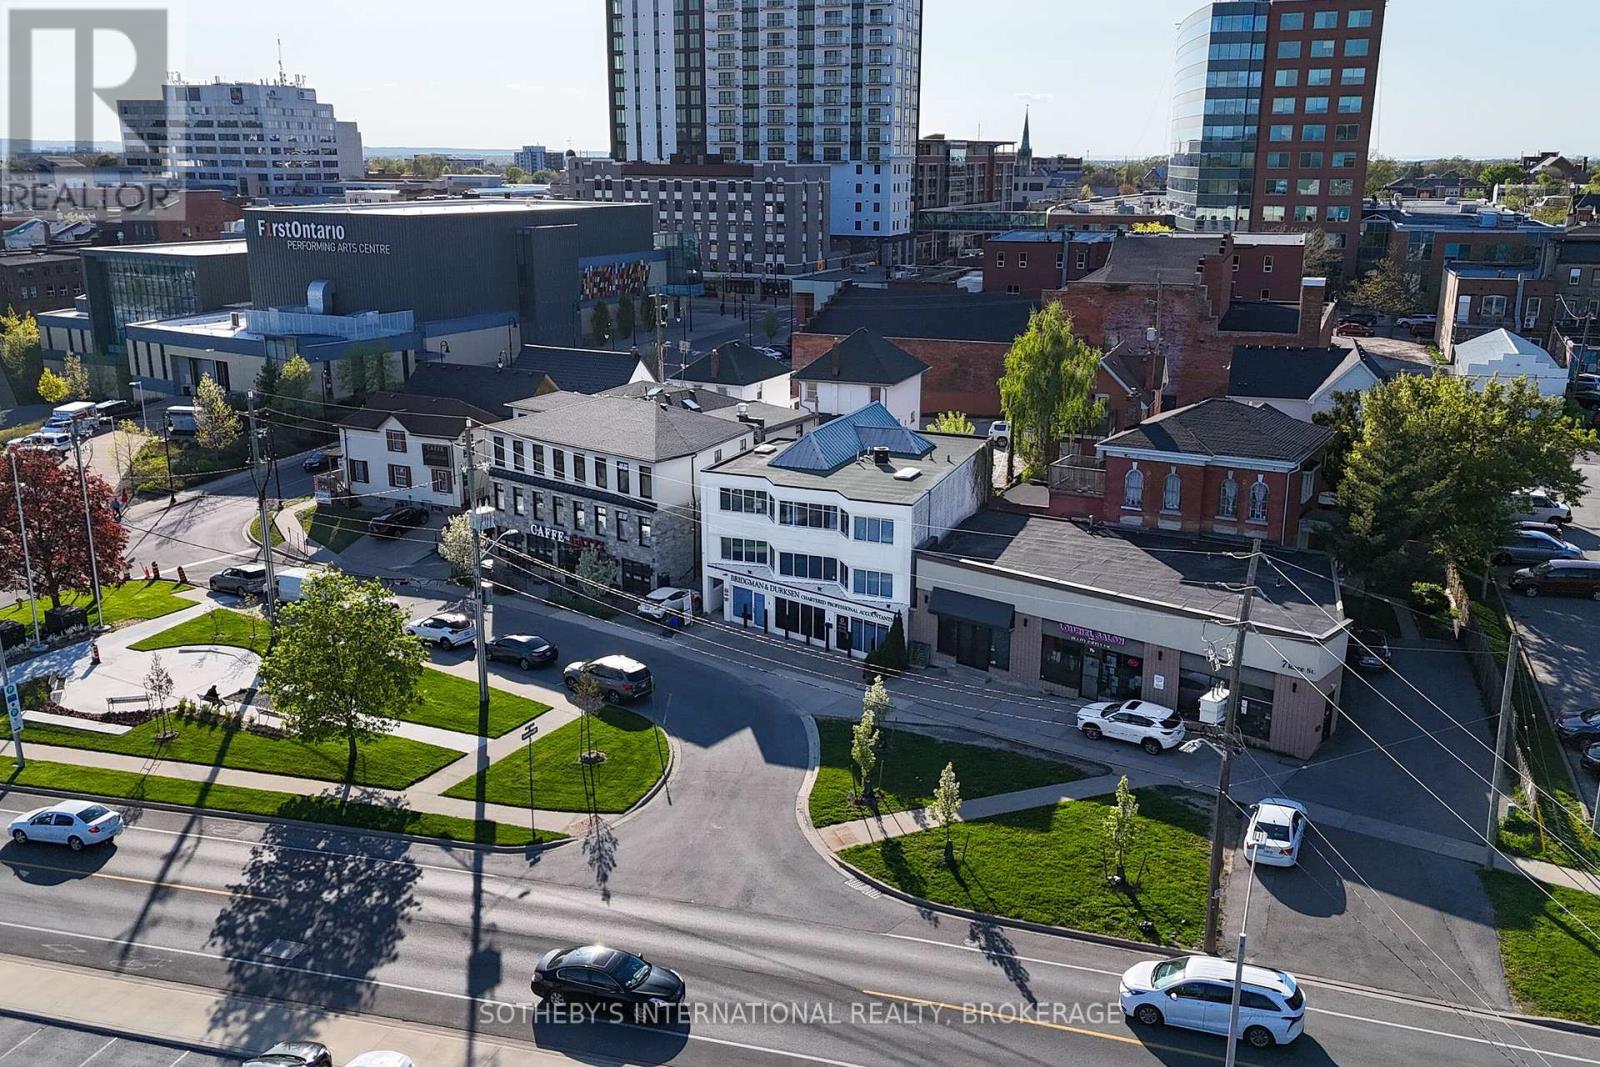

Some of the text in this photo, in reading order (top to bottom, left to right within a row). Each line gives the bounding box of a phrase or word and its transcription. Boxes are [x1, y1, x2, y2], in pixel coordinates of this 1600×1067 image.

[287, 240, 391, 255] PERFORMING ARTS CENTRE
[530, 524, 565, 543] CAFFE
[730, 575, 764, 589] BRIDGMAN
[769, 584, 800, 599] DURKSEN
